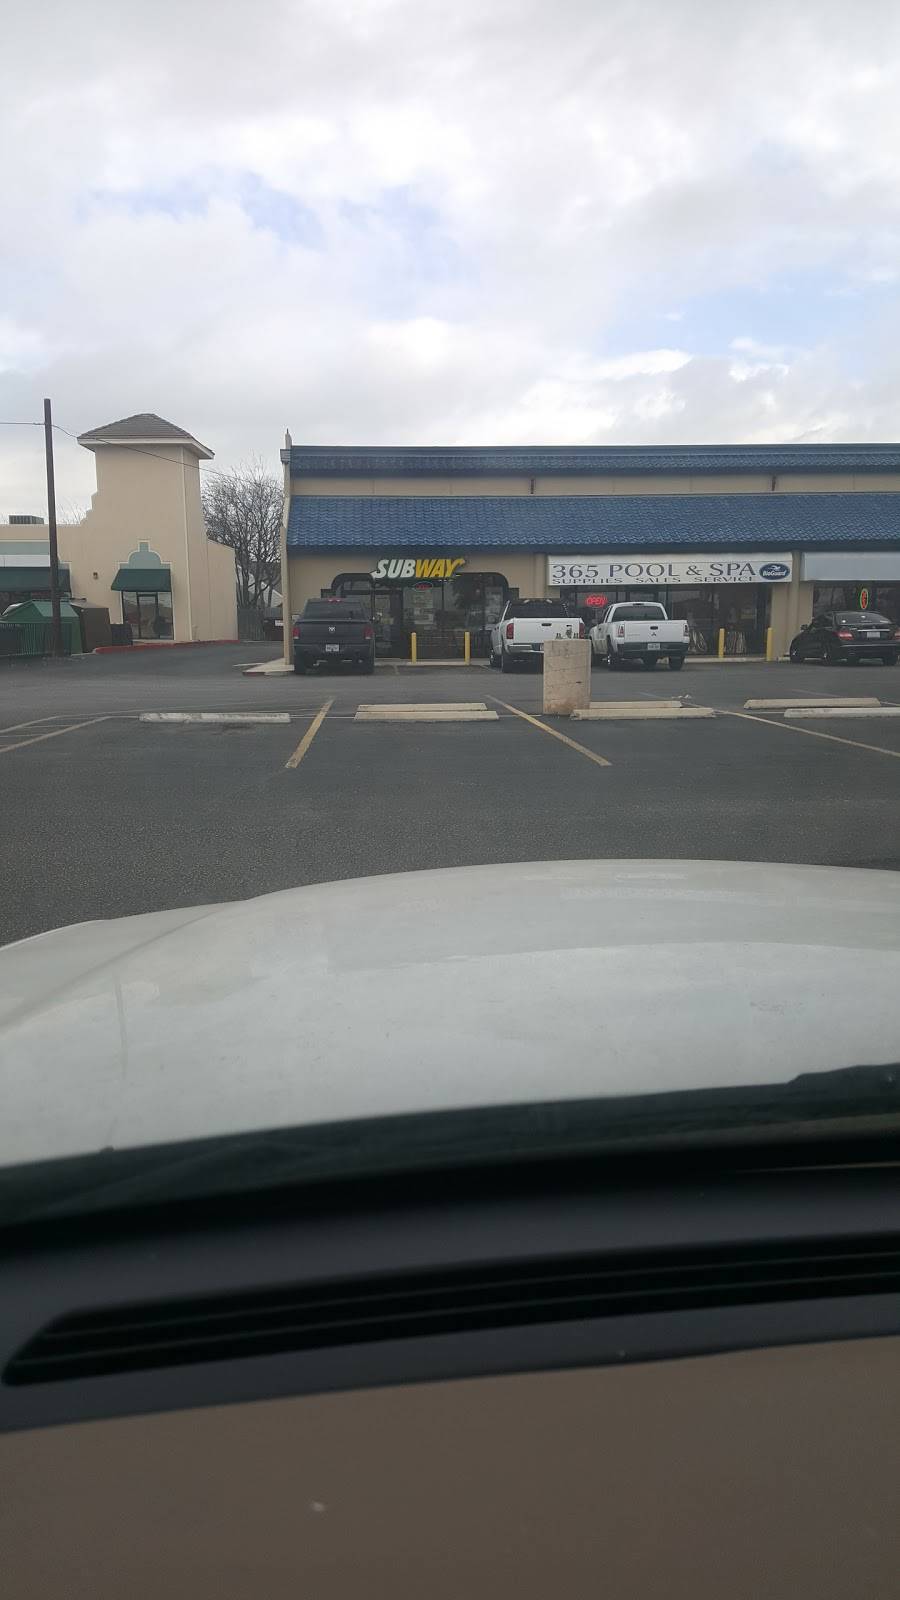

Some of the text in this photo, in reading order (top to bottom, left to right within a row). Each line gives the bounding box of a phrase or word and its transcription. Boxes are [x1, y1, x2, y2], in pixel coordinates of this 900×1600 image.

[370, 558, 465, 578] SUBWAY
[552, 562, 756, 578] 365 POOL & SPA
